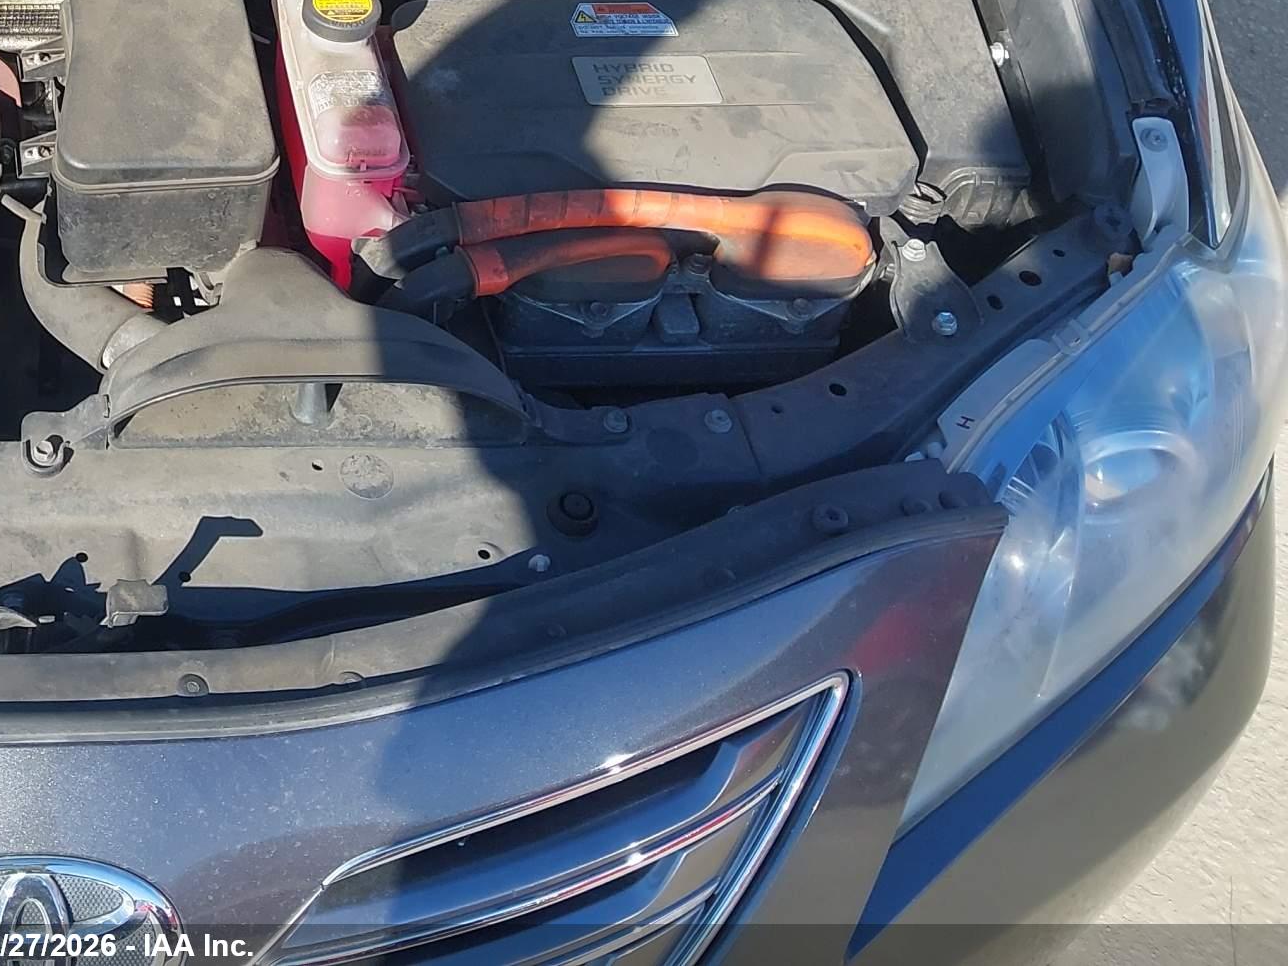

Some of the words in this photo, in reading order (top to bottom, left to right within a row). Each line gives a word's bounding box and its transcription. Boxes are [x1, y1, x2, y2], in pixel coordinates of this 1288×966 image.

[593, 63, 675, 73] HYBRID
[598, 75, 696, 84] SYNERGY
[602, 86, 666, 96] DRIVE
